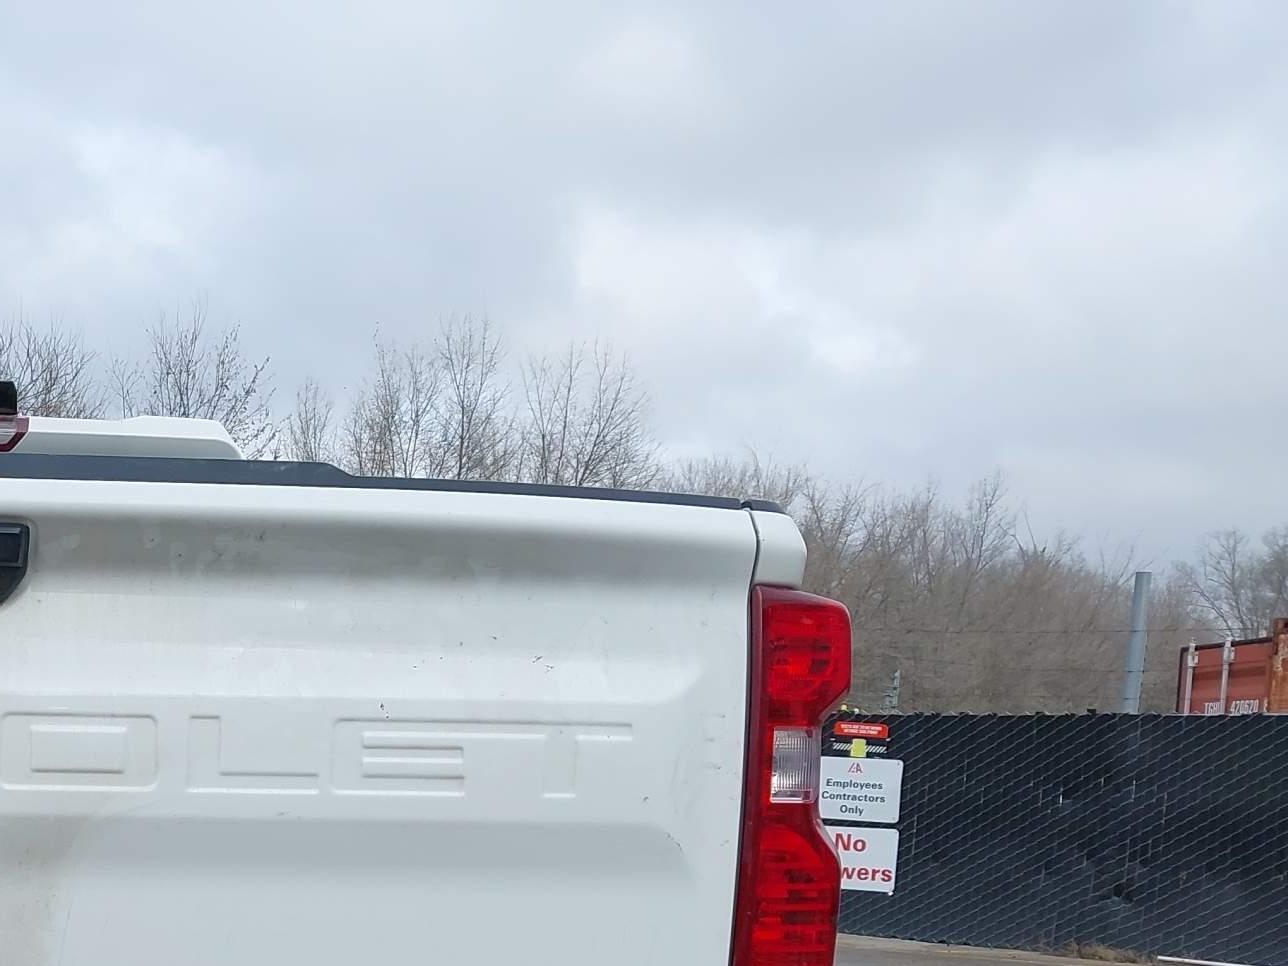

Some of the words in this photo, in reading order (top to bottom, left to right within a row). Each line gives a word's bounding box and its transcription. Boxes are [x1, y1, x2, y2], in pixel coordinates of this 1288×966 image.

[826, 778, 883, 790] Employees
[821, 790, 886, 803] Contractors
[839, 804, 864, 816] Only
[835, 833, 866, 852] No
